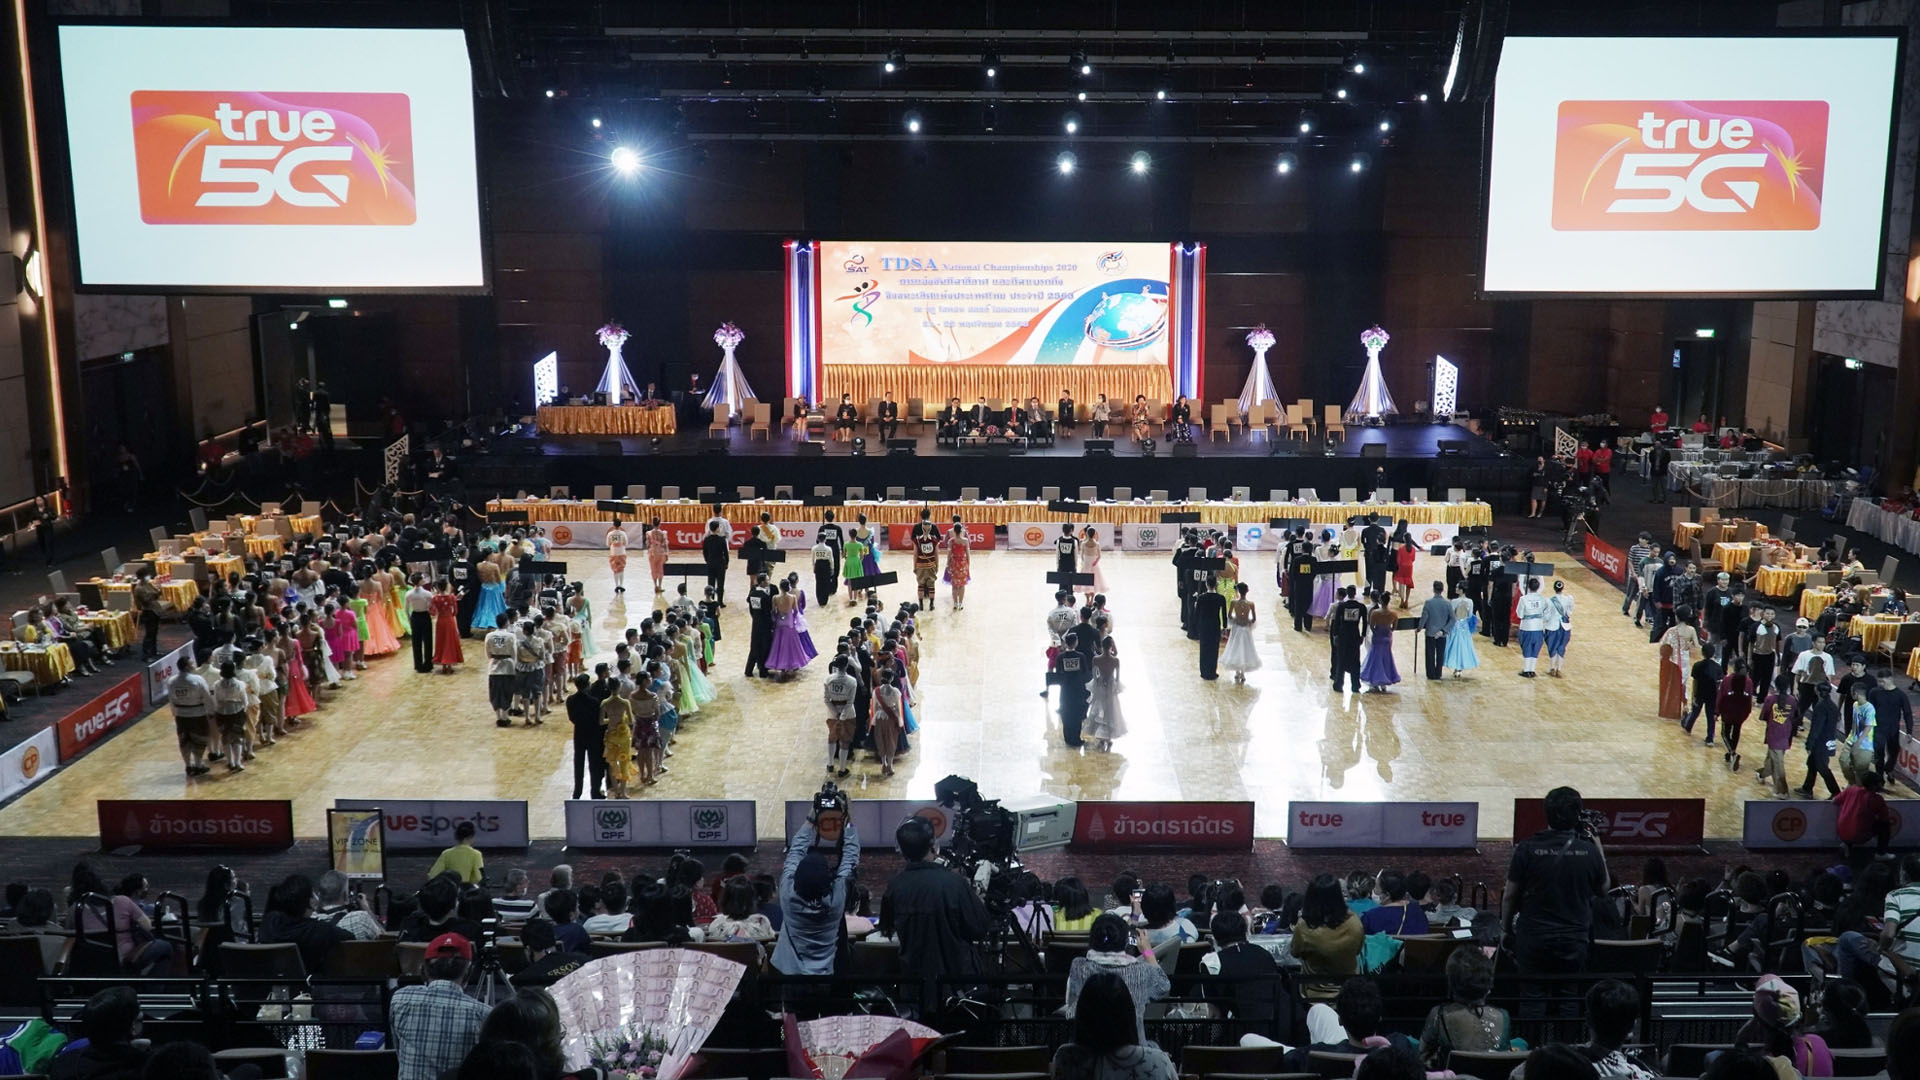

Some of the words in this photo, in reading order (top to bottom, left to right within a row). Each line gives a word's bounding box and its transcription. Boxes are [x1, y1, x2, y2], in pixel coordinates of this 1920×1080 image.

[214, 102, 337, 142] true
[1638, 111, 1754, 150] true
[194, 144, 354, 208] 5G
[1604, 152, 1769, 213] 5G
[880, 257, 939, 272] TDSA
[942, 263, 980, 271] National
[983, 263, 1053, 273] Championships
[780, 527, 805, 538] true
[1027, 532, 1042, 541] CP
[1424, 534, 1440, 542] CP
[154, 664, 173, 683] true
[23, 753, 38, 771] CP
[150, 813, 273, 834] ข้าวตราฉัตร
[1113, 814, 1235, 835] ข้าวตราฉัตร
[1299, 810, 1343, 827] true
[1421, 810, 1465, 827] true
[1777, 816, 1804, 833] CP
[335, 838, 349, 846] VIP
[351, 838, 378, 846] ZONE
[601, 831, 625, 839] CPF
[698, 831, 722, 839] CPF
